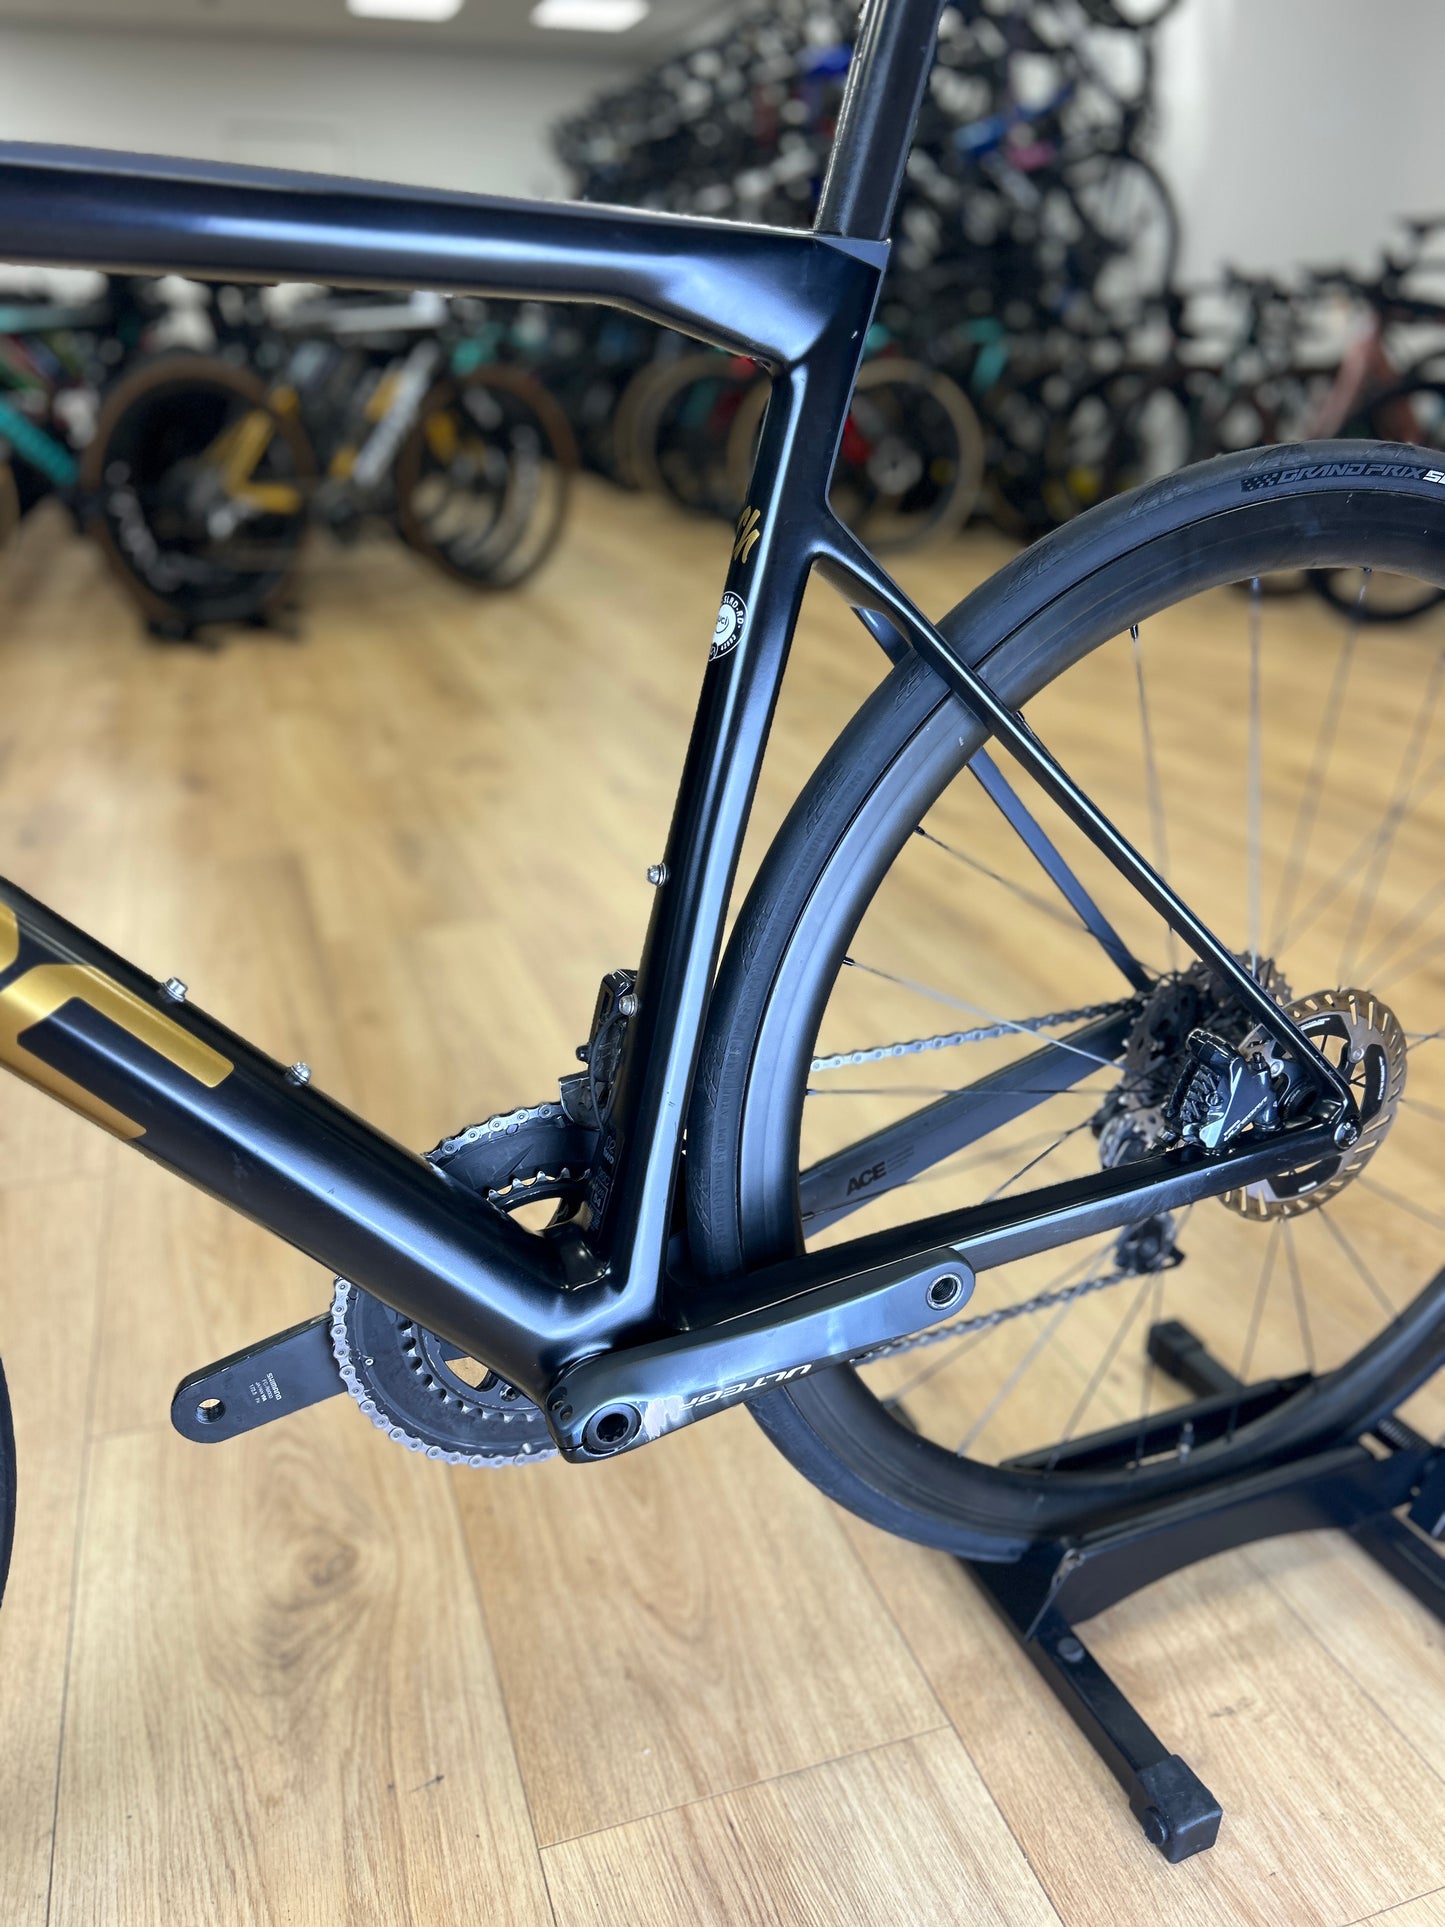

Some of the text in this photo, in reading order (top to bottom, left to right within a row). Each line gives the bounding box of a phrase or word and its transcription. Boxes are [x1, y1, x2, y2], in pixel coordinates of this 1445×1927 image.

[1277, 463, 1366, 484] GRAND
[1366, 463, 1426, 479] PRIX
[846, 1160, 887, 1196] ACE
[266, 1372, 282, 1401] SHIMANO
